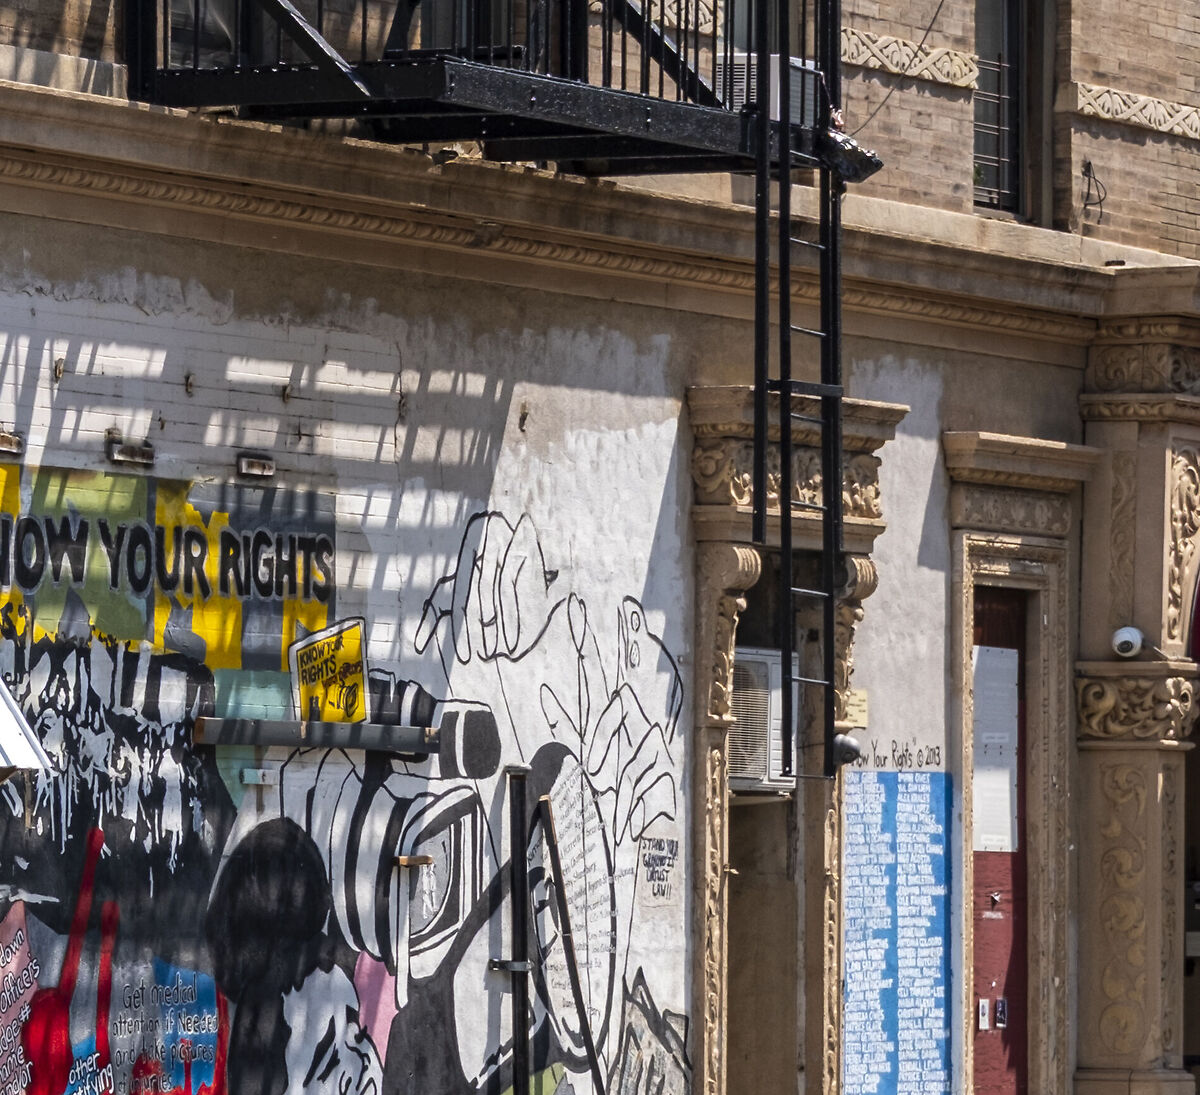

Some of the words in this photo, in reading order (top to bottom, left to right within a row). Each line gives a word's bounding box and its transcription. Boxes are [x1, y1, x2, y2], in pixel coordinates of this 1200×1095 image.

[97, 517, 213, 600] YOUR
[218, 528, 335, 603] RIGHTS
[300, 643, 325, 668] KNOW
[301, 654, 337, 686] RIGHTS
[871, 739, 888, 768] Your
[925, 745, 941, 767] 2013
[0, 928, 25, 968] down
[122, 978, 146, 1010] Get
[151, 973, 197, 1006] medical
[112, 1009, 161, 1038] attention
[166, 1008, 175, 1034] if
[179, 1008, 220, 1035] Needed
[69, 1052, 101, 1085] other
[115, 1040, 137, 1068] and
[140, 1036, 167, 1062] take
[170, 1039, 215, 1071] pictures
